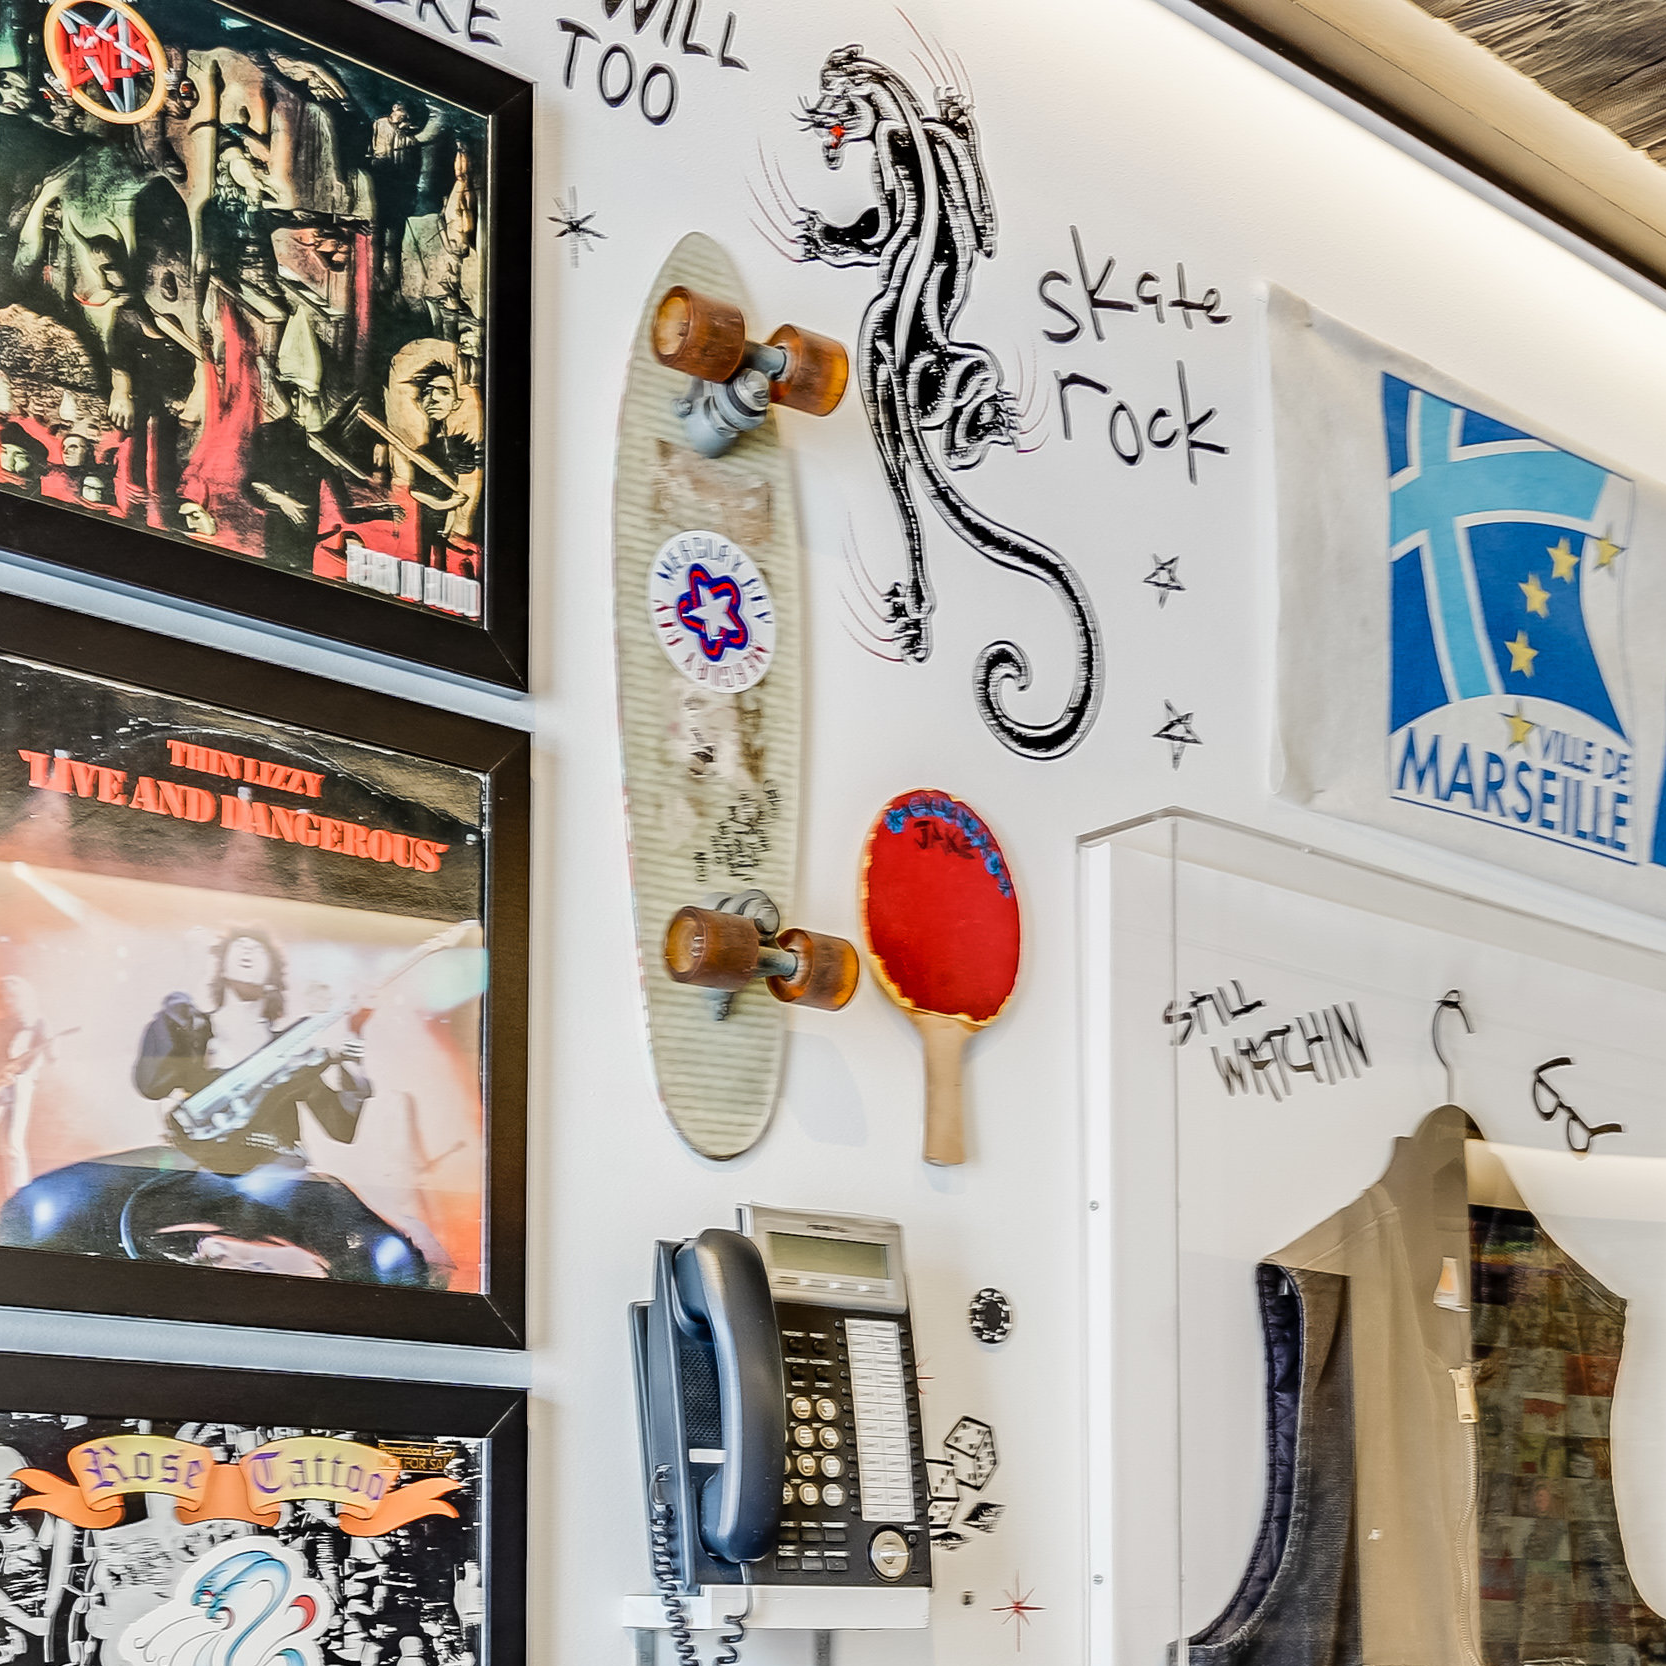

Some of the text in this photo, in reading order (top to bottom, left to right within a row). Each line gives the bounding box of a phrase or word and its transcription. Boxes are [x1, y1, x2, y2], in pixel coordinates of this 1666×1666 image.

[556, 18, 680, 126] TOO
[1037, 225, 1232, 346] skate
[1054, 360, 1231, 486] rock
[167, 739, 326, 798] THIN LIZZY
[1538, 723, 1630, 785] VILLE DE
[129, 774, 216, 824] AND
[1398, 726, 1631, 852] MARSEILLE
[1163, 978, 1265, 1047] STILL
[81, 1446, 392, 1502] Rose Tattoo
